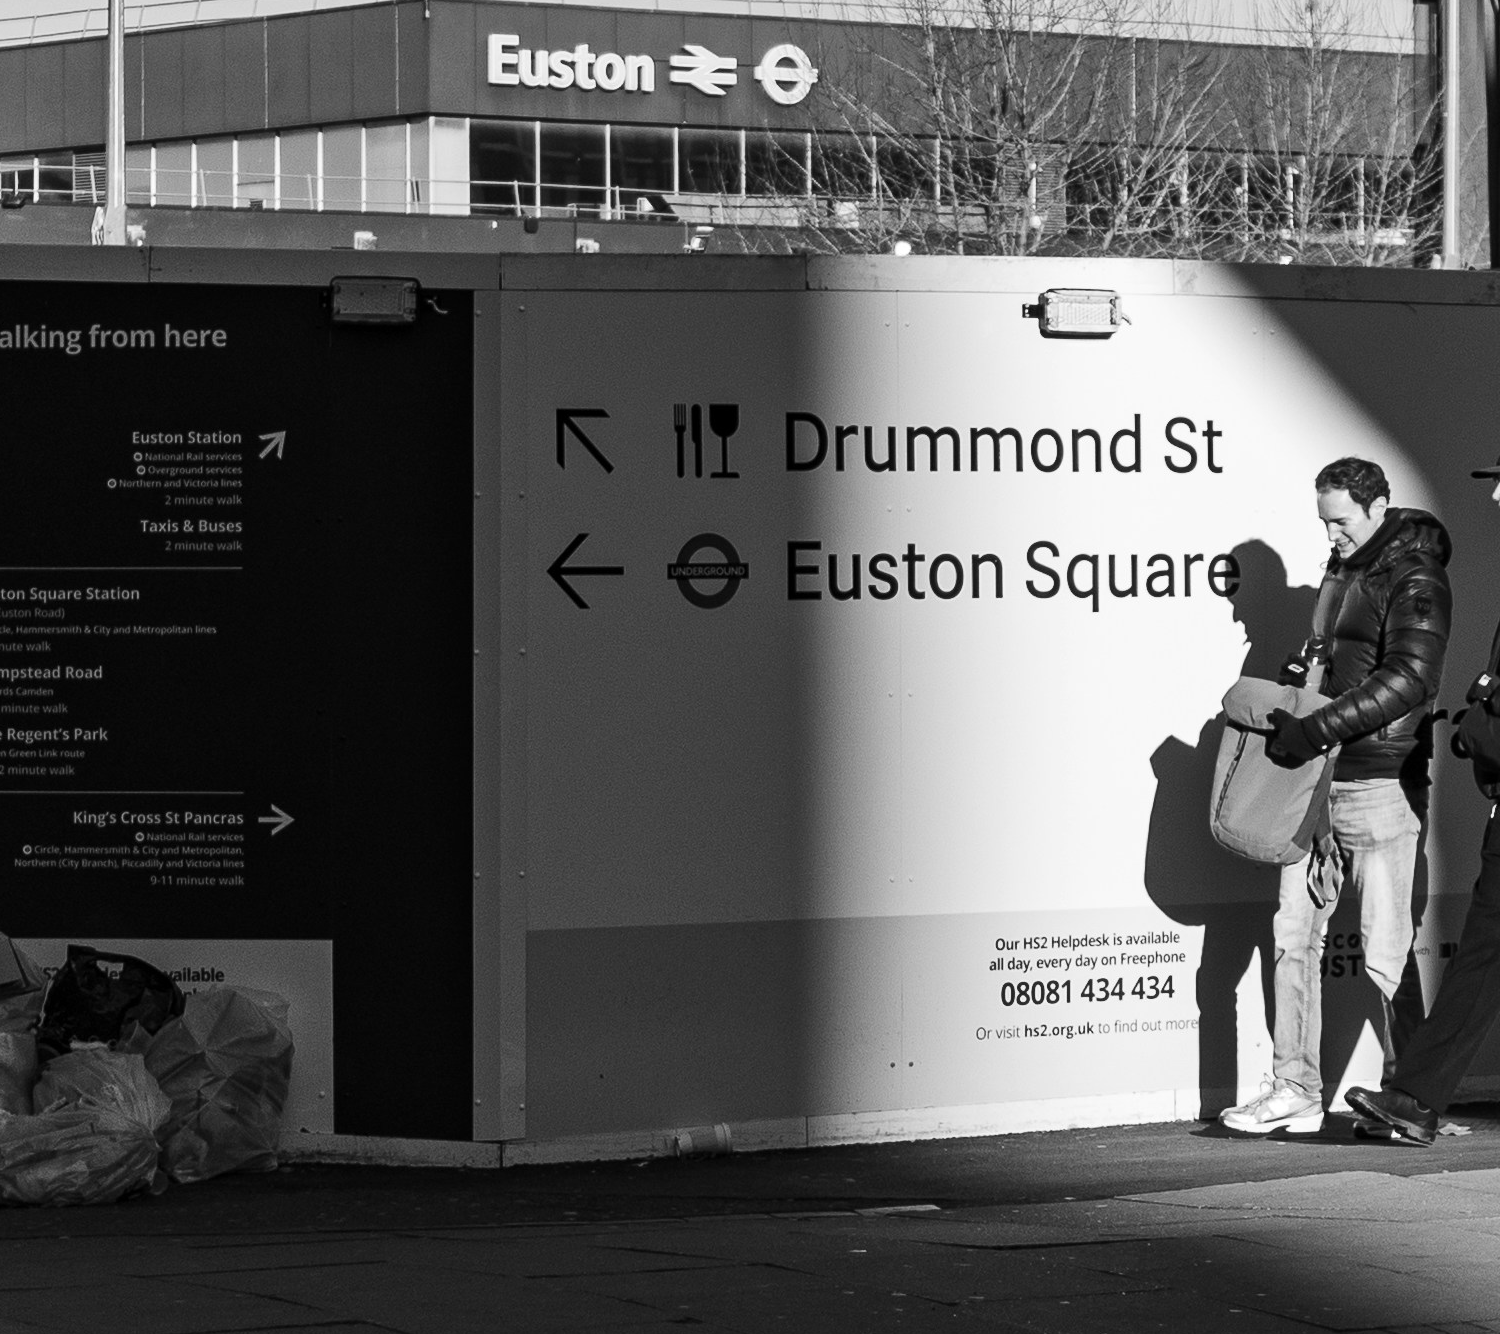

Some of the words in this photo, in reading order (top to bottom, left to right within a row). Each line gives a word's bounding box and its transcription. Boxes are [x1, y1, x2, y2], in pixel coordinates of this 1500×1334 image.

[487, 33, 655, 94] Euston
[88, 323, 155, 348] from
[164, 323, 227, 347] here
[131, 431, 183, 444] Euston
[187, 430, 242, 444] Station
[786, 413, 1142, 473] Drummond
[1163, 416, 1223, 474] St
[144, 452, 184, 461] National
[185, 451, 204, 461] Rail
[205, 453, 243, 461] services
[147, 465, 204, 476] Overground
[205, 466, 243, 474] services
[118, 478, 162, 488] Northern
[163, 478, 182, 488] and
[183, 479, 219, 487] Victoria
[220, 478, 243, 487] lines
[164, 494, 171, 505] 2
[173, 495, 214, 505] minute
[215, 494, 242, 505] walk
[139, 519, 179, 533] Taxis
[182, 519, 194, 532] &
[198, 519, 243, 532] Buses
[164, 540, 172, 551] 2
[173, 541, 214, 551] minute
[215, 540, 242, 551] walk
[670, 565, 747, 578] UNDERGROUND
[786, 541, 1004, 600] Euston
[1024, 540, 1243, 613] Square
[29, 587, 82, 603] Square
[85, 586, 140, 600] Station
[33, 607, 65, 619] Road)
[15, 625, 82, 634] Hammersmith
[83, 624, 91, 634] &
[92, 625, 111, 636] City
[112, 625, 131, 634] and
[132, 625, 193, 635] Metropolitan
[194, 624, 217, 634] lines
[25, 640, 51, 651] walk
[65, 665, 103, 679] Road
[15, 686, 54, 696] Camden
[0, 704, 40, 713] minute
[41, 703, 68, 713] walk
[73, 727, 108, 740] Park
[7, 748, 37, 758] Green
[38, 749, 58, 758] Link
[59, 749, 85, 758] route
[7, 765, 47, 775] minute
[48, 764, 75, 775] walk
[120, 810, 161, 824] Cross
[164, 811, 180, 824] St
[183, 811, 244, 824] Pancras
[146, 832, 186, 841] National
[187, 832, 205, 841] Rail
[33, 844, 61, 854] Circle,
[63, 845, 131, 854] Hammersmith
[132, 845, 140, 855] &
[141, 845, 160, 856] City
[161, 846, 180, 855] and
[181, 846, 244, 856] Metropolitan,
[13, 858, 57, 867] Northern
[57, 858, 79, 869] (City
[80, 858, 119, 868] Branch),
[121, 858, 164, 869] Piccadilly
[165, 859, 184, 868] and
[185, 859, 221, 868] Victoria
[222, 859, 245, 868] lines
[149, 874, 173, 885] 9-11
[175, 876, 216, 885] minute
[218, 875, 244, 885] walk
[995, 938, 1020, 951] Our
[1024, 937, 1048, 950] HS2
[1051, 935, 1109, 949] Helpdesk
[1113, 936, 1123, 946] is
[1126, 932, 1180, 945] available
[989, 958, 1004, 971] all
[1007, 957, 1033, 973] day,
[1036, 958, 1072, 971] every
[1075, 955, 1098, 970] day
[1101, 956, 1117, 966] on
[1121, 952, 1186, 967] Freephone
[1001, 980, 1071, 1006] 08081
[1081, 978, 1125, 1002] 434
[1131, 976, 1175, 1000] 434
[976, 1027, 992, 1041] Or
[995, 1027, 1020, 1039] visit
[1024, 1023, 1095, 1039] hs2.org.uk
[1098, 1023, 1111, 1034] to
[1114, 1021, 1138, 1032] find
[1142, 1020, 1162, 1032] out
[1166, 1019, 1199, 1031] more
